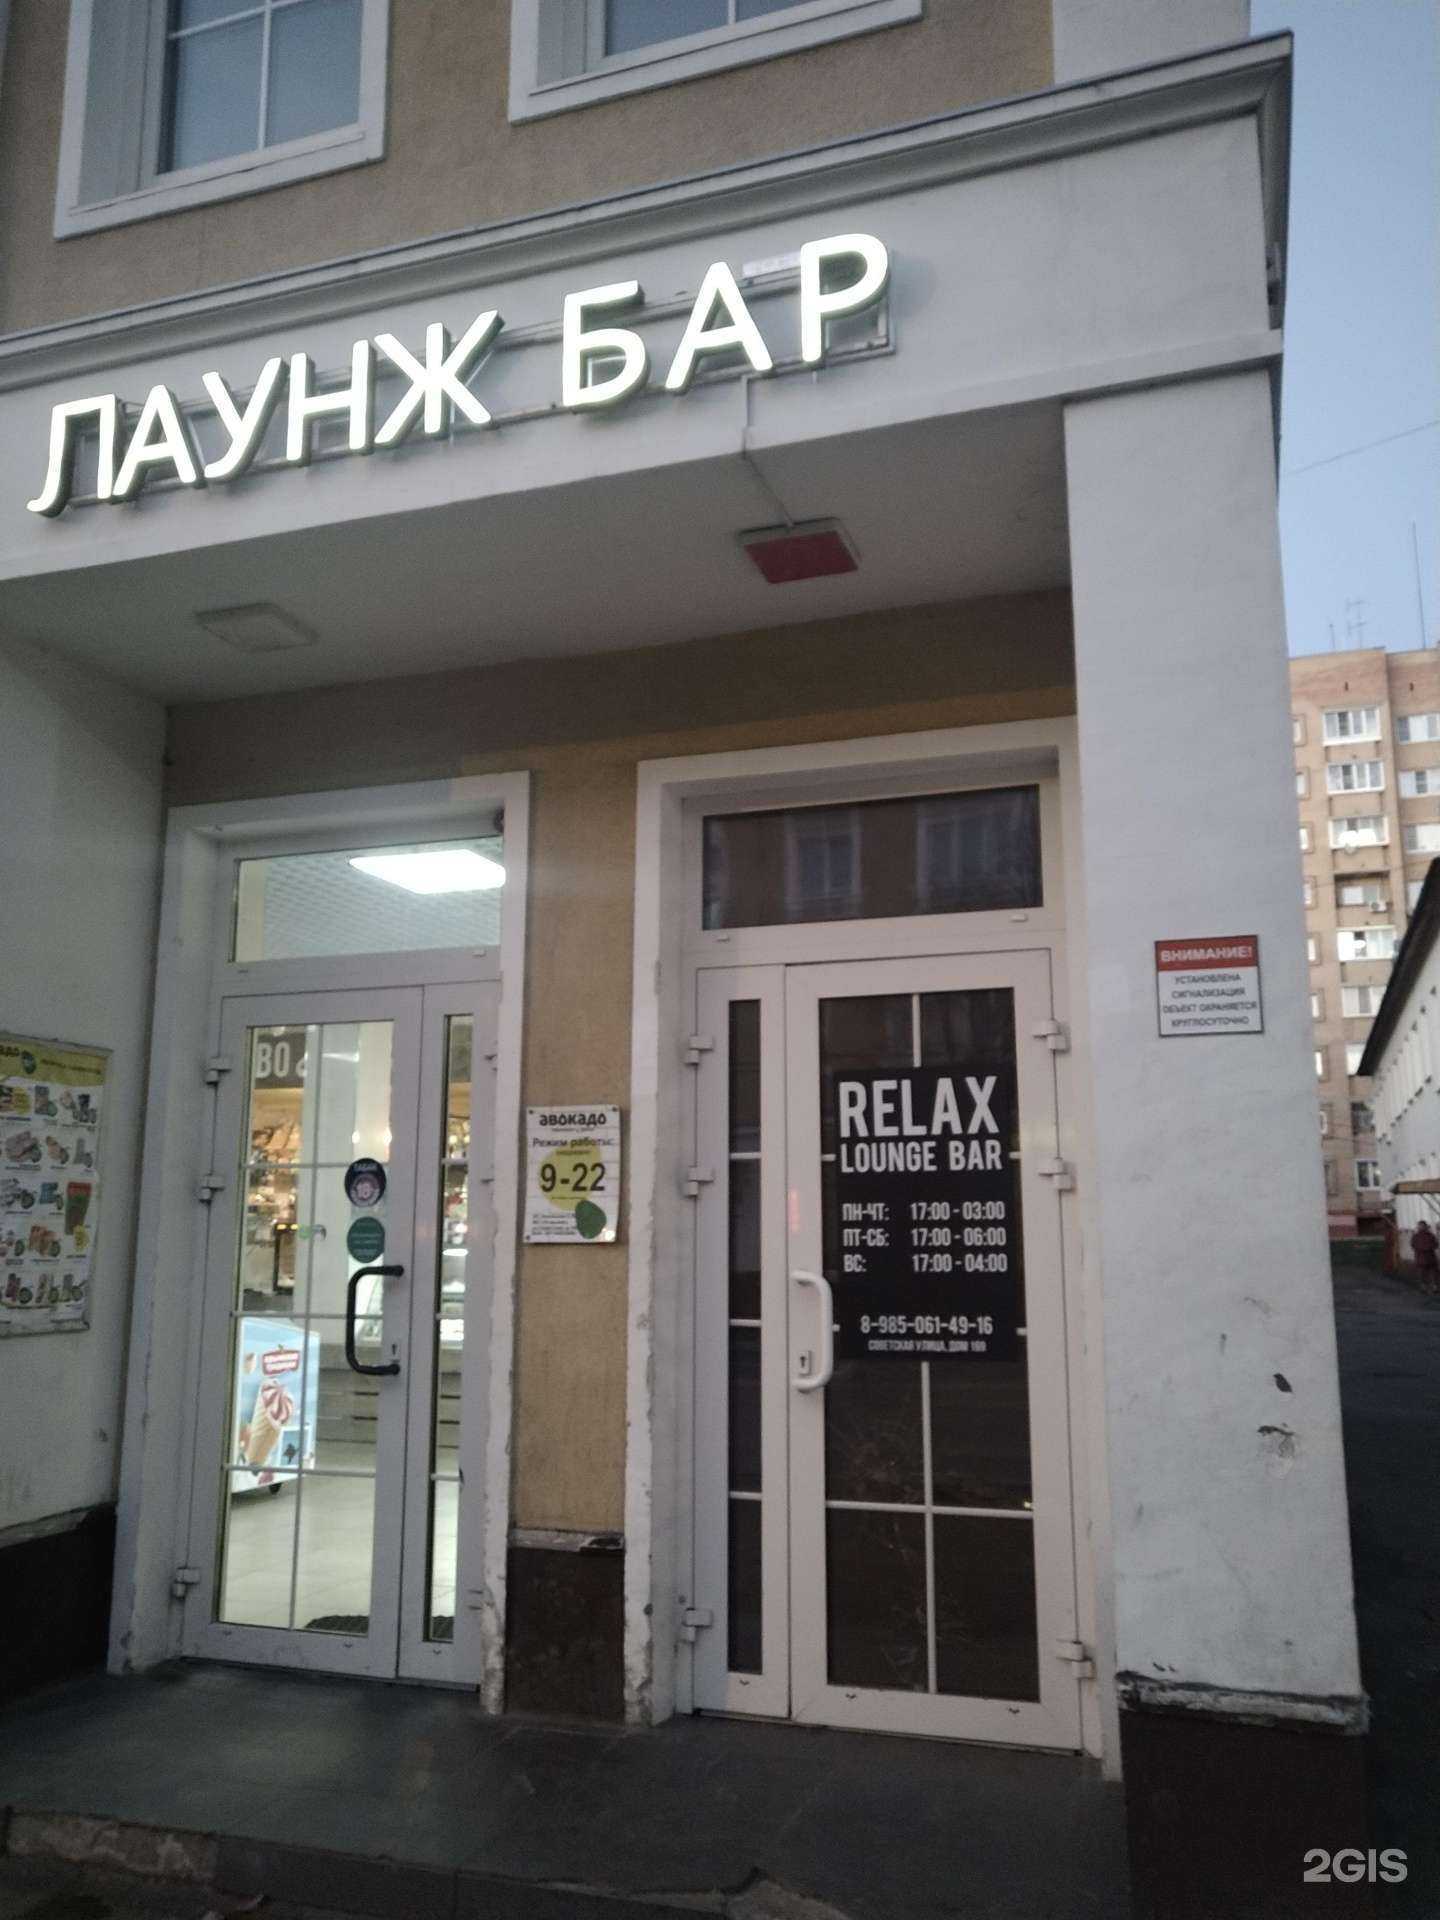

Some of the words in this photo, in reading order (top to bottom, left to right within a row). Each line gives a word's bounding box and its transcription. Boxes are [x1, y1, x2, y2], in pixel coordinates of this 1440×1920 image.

[27, 309, 502, 516] ЛАУНЖ
[562, 232, 890, 409] БАР
[1160, 945, 1253, 963] ВНИМАНИЕ!
[838, 1075, 1001, 1139] RELAX
[539, 1113, 607, 1127] авокадо
[840, 1141, 938, 1173] LOUNGE
[949, 1138, 1003, 1171] BAR
[909, 1202, 950, 1221] 17:00
[962, 1201, 1006, 1220] 03:00
[911, 1227, 951, 1247] 17:00
[963, 1227, 1007, 1246] 06:00
[912, 1253, 953, 1273] 17:00
[964, 1253, 1009, 1273] 04:00
[860, 1314, 993, 1335] 8-985-061-49-16
